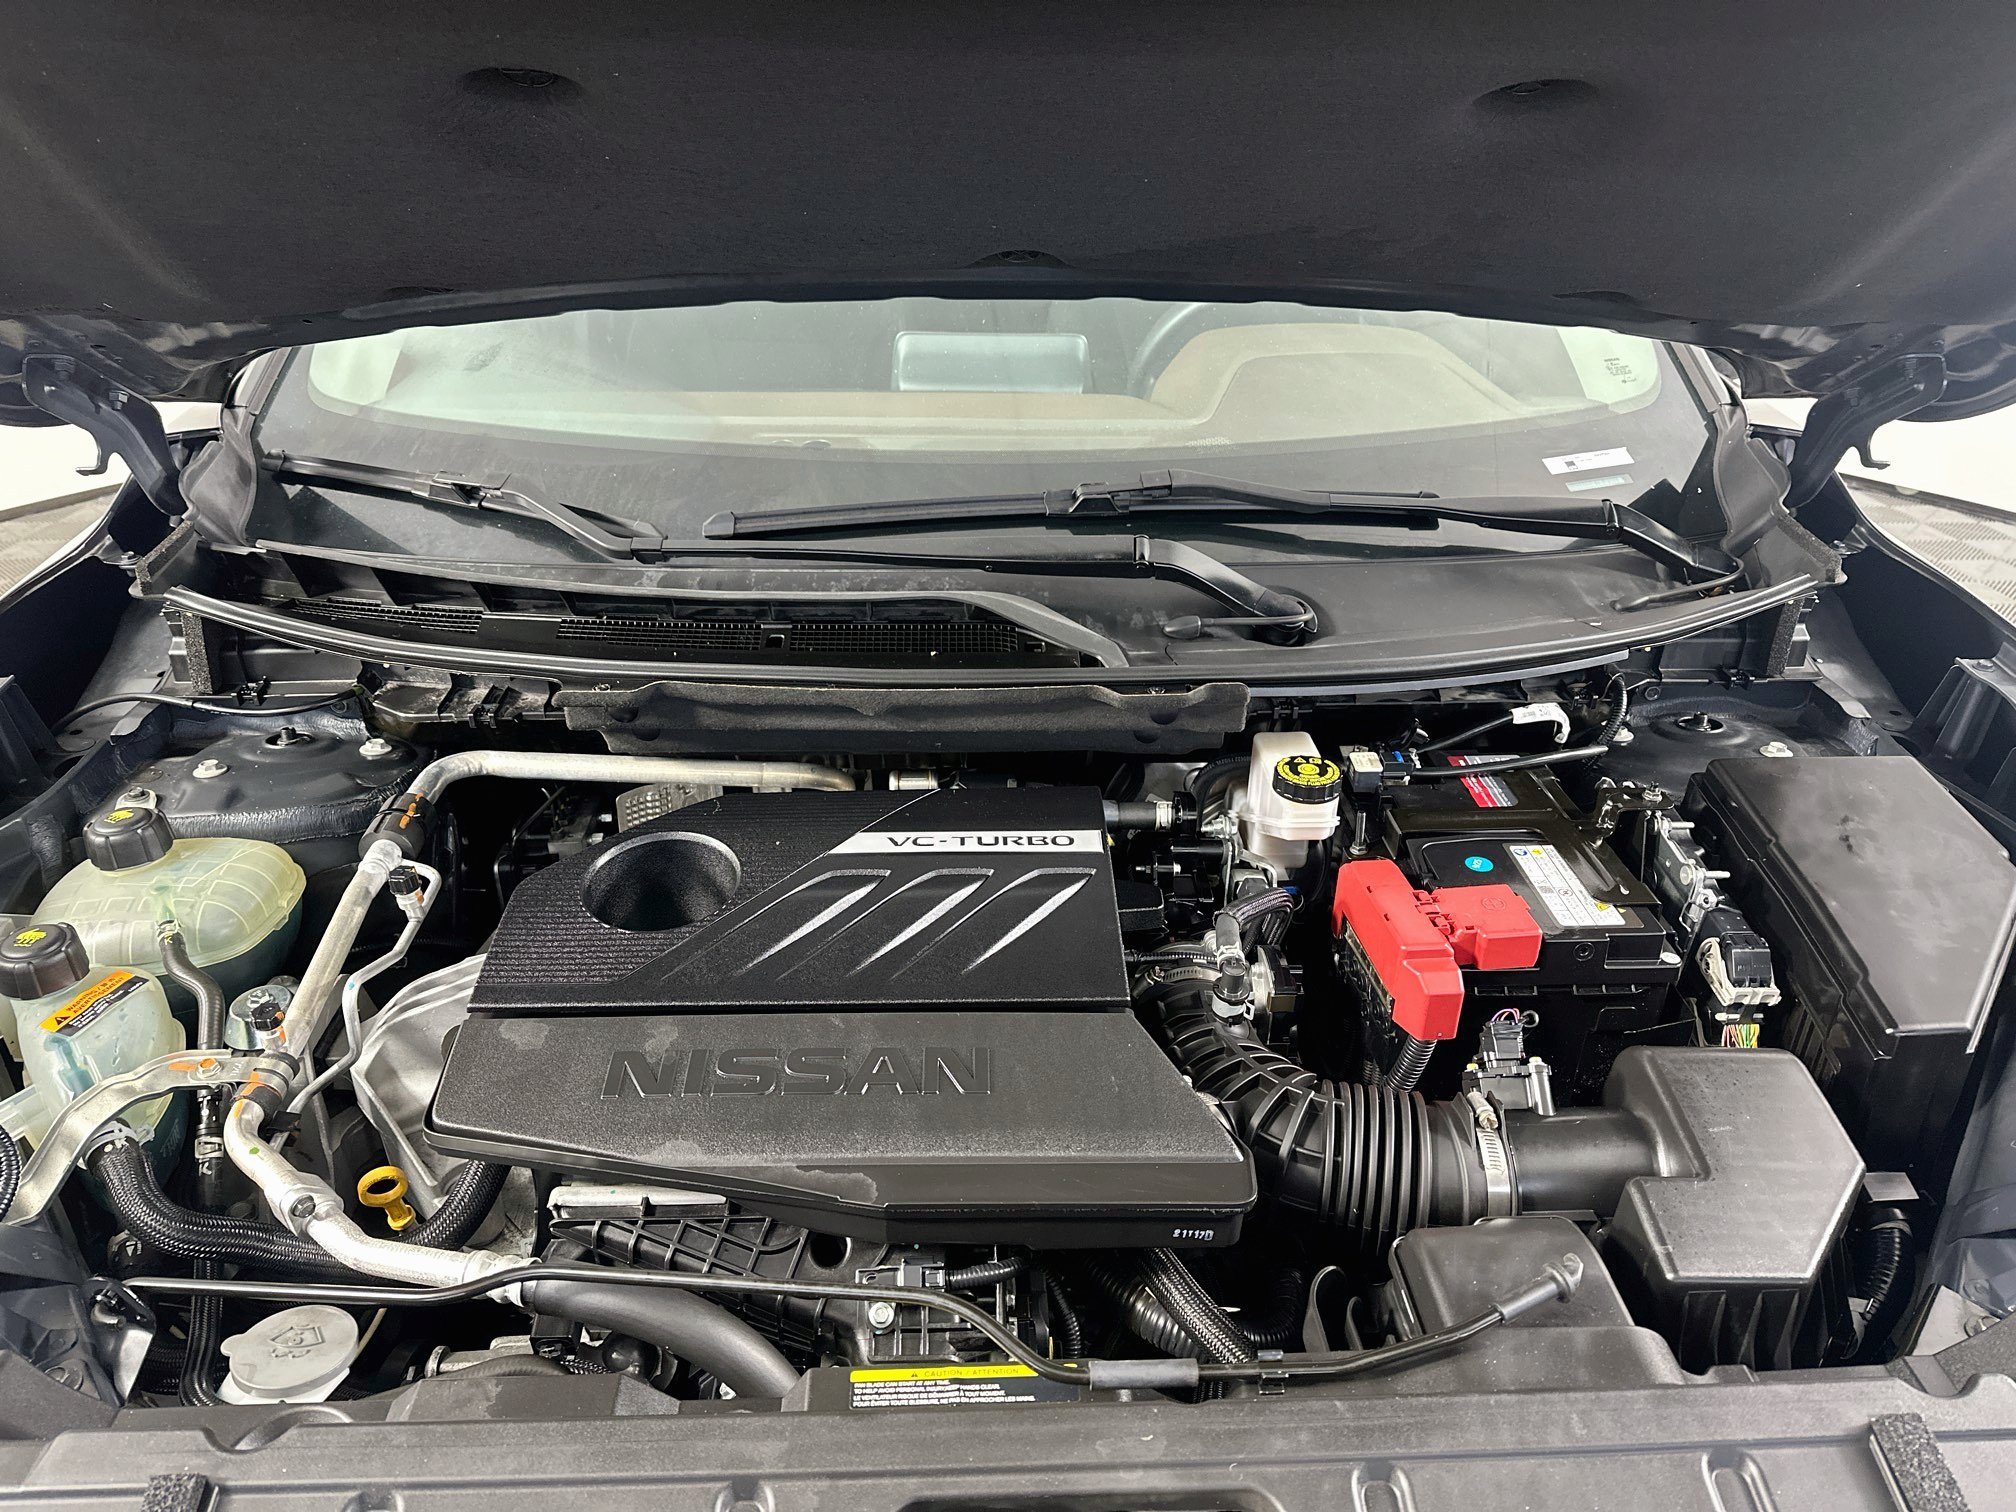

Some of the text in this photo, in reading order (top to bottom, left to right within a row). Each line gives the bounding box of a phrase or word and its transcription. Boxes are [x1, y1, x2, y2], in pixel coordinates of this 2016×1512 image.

[887, 835, 1075, 847] VC-TURBO
[601, 1047, 990, 1099] NISSAN
[924, 1369, 962, 1378] CAUTION
[972, 1368, 1019, 1376] ATTENTION
